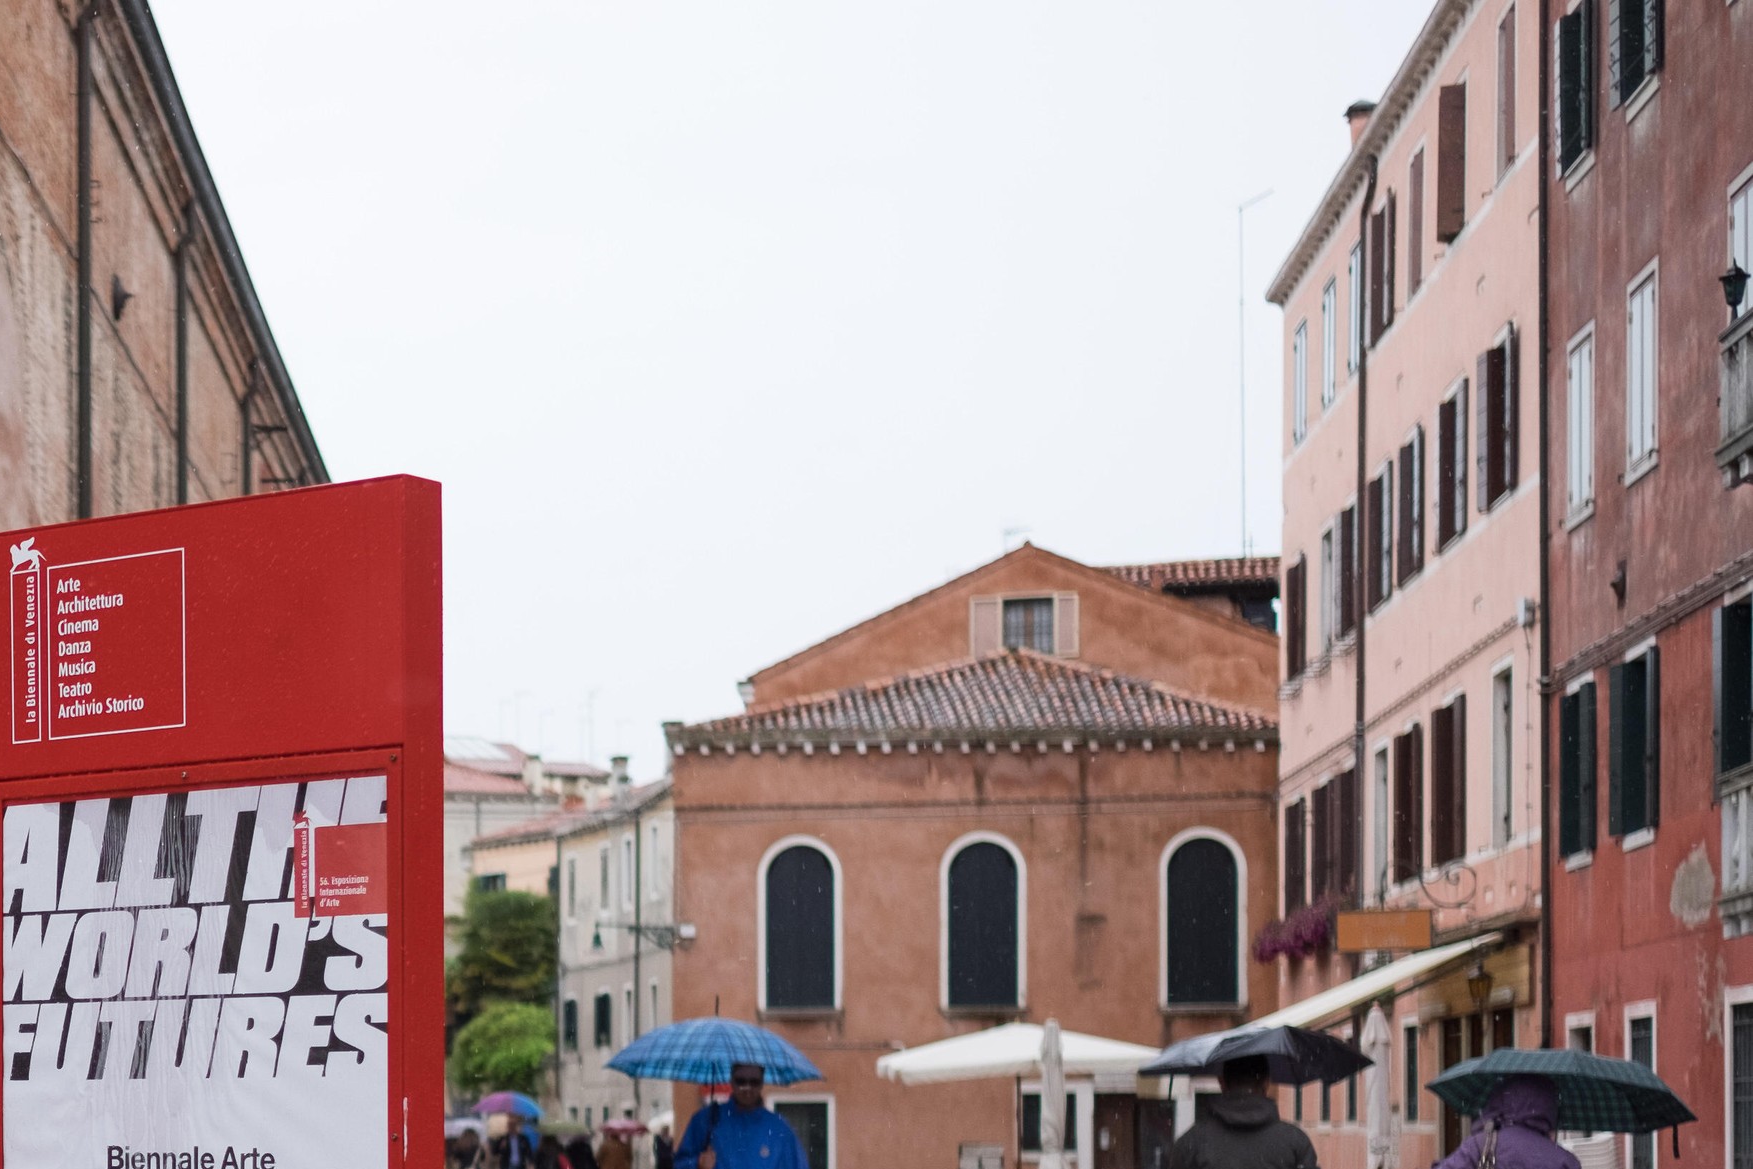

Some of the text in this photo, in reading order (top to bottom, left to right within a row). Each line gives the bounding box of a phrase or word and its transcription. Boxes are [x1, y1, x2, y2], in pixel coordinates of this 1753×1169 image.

[56, 578, 80, 594] Arte
[57, 593, 124, 615] Architettura
[57, 618, 99, 636] Cinema
[25, 575, 36, 723] la Biennale di Venezia
[58, 640, 91, 657] Danza
[58, 658, 96, 678] Musica
[58, 681, 92, 698] Teatro
[57, 694, 144, 719] Archivio Storico
[3, 901, 388, 1002] WORLD'S
[3, 993, 388, 1081] FUTURES
